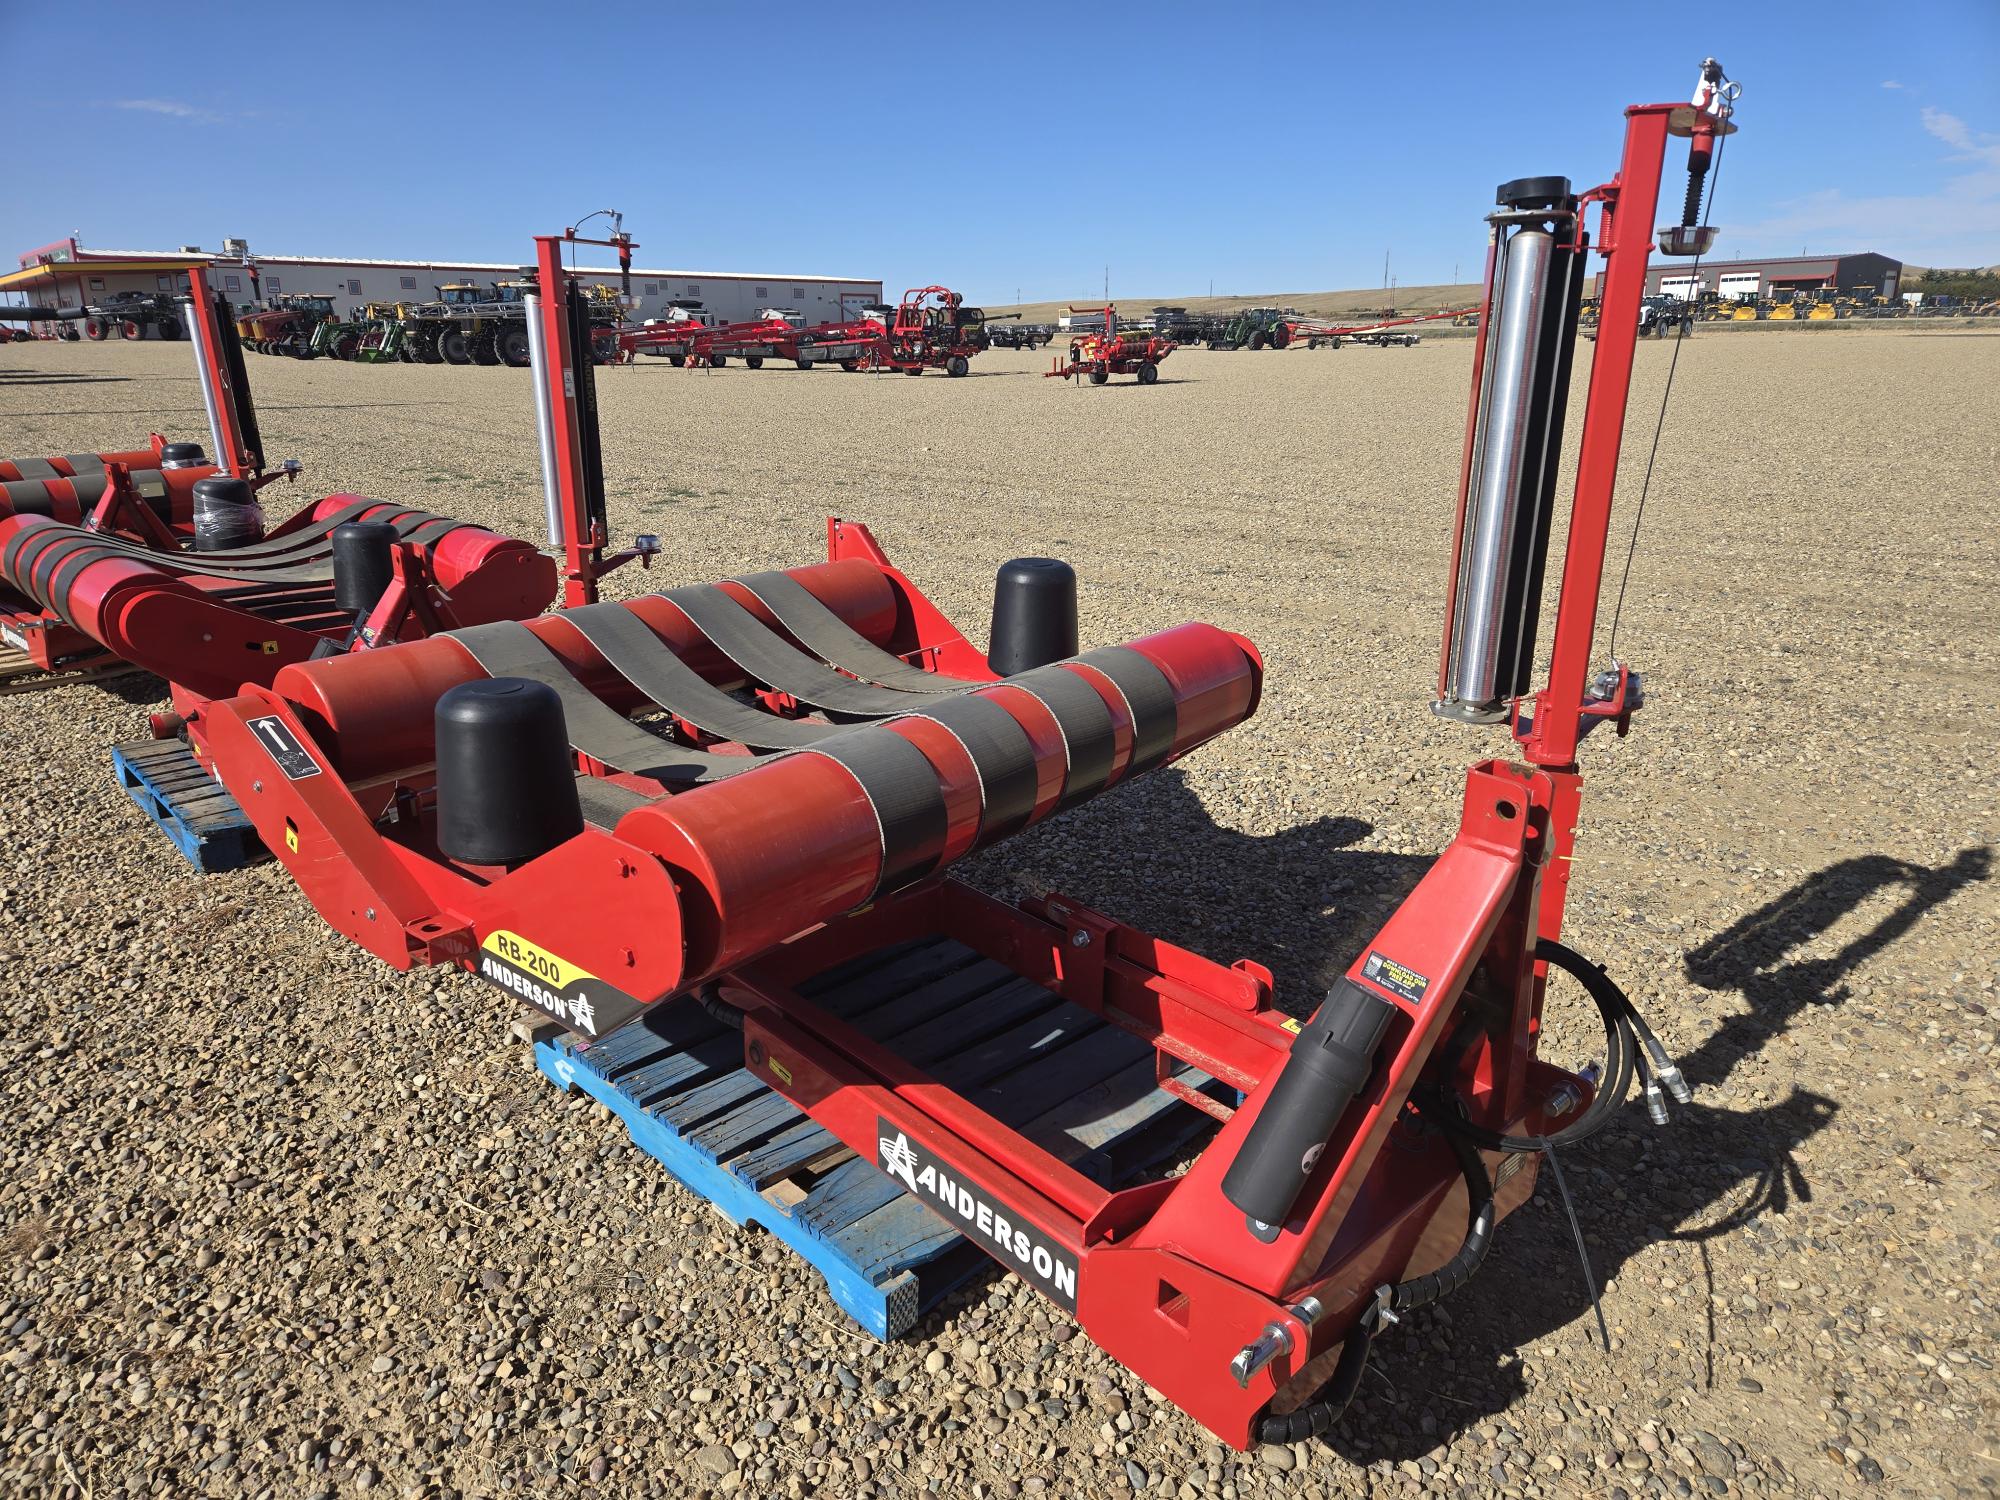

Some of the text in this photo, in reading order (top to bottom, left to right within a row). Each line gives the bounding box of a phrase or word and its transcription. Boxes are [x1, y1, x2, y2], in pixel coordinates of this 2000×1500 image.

[497, 933, 561, 983] RB-200
[1382, 961, 1414, 981] DOWNLOAD
[1413, 978, 1427, 988] OUR
[1388, 971, 1403, 981] FREE
[1402, 979, 1416, 988] APP
[482, 957, 567, 1019] ANDERSON
[916, 1164, 1076, 1300] ANDERSON
